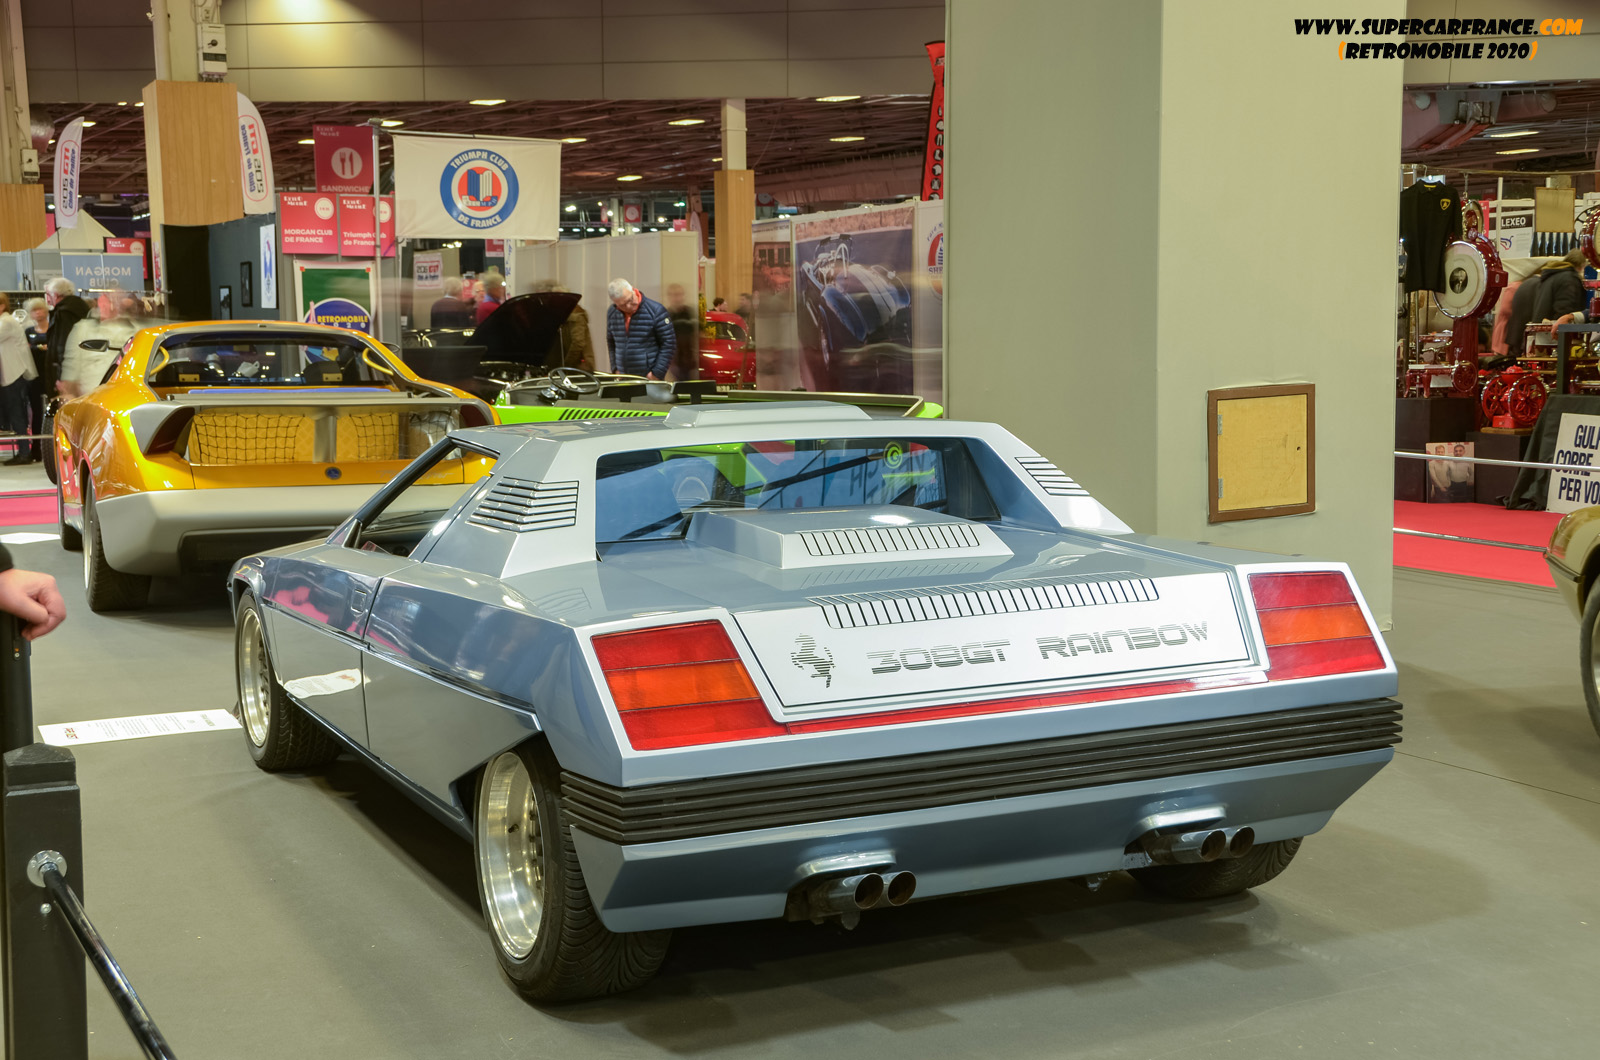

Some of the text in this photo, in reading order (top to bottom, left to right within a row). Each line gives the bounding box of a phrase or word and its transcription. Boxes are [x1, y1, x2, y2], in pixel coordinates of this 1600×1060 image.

[450, 150, 509, 171] TRIUMPH CLUB
[321, 185, 370, 193] SANDWICHE
[457, 213, 502, 228] DE FRANCE
[343, 231, 371, 240] Triumph
[317, 315, 369, 323] RETROMOBILE
[1558, 476, 1600, 505] PER VO
[866, 621, 1208, 675] 308GT RAINBOW
